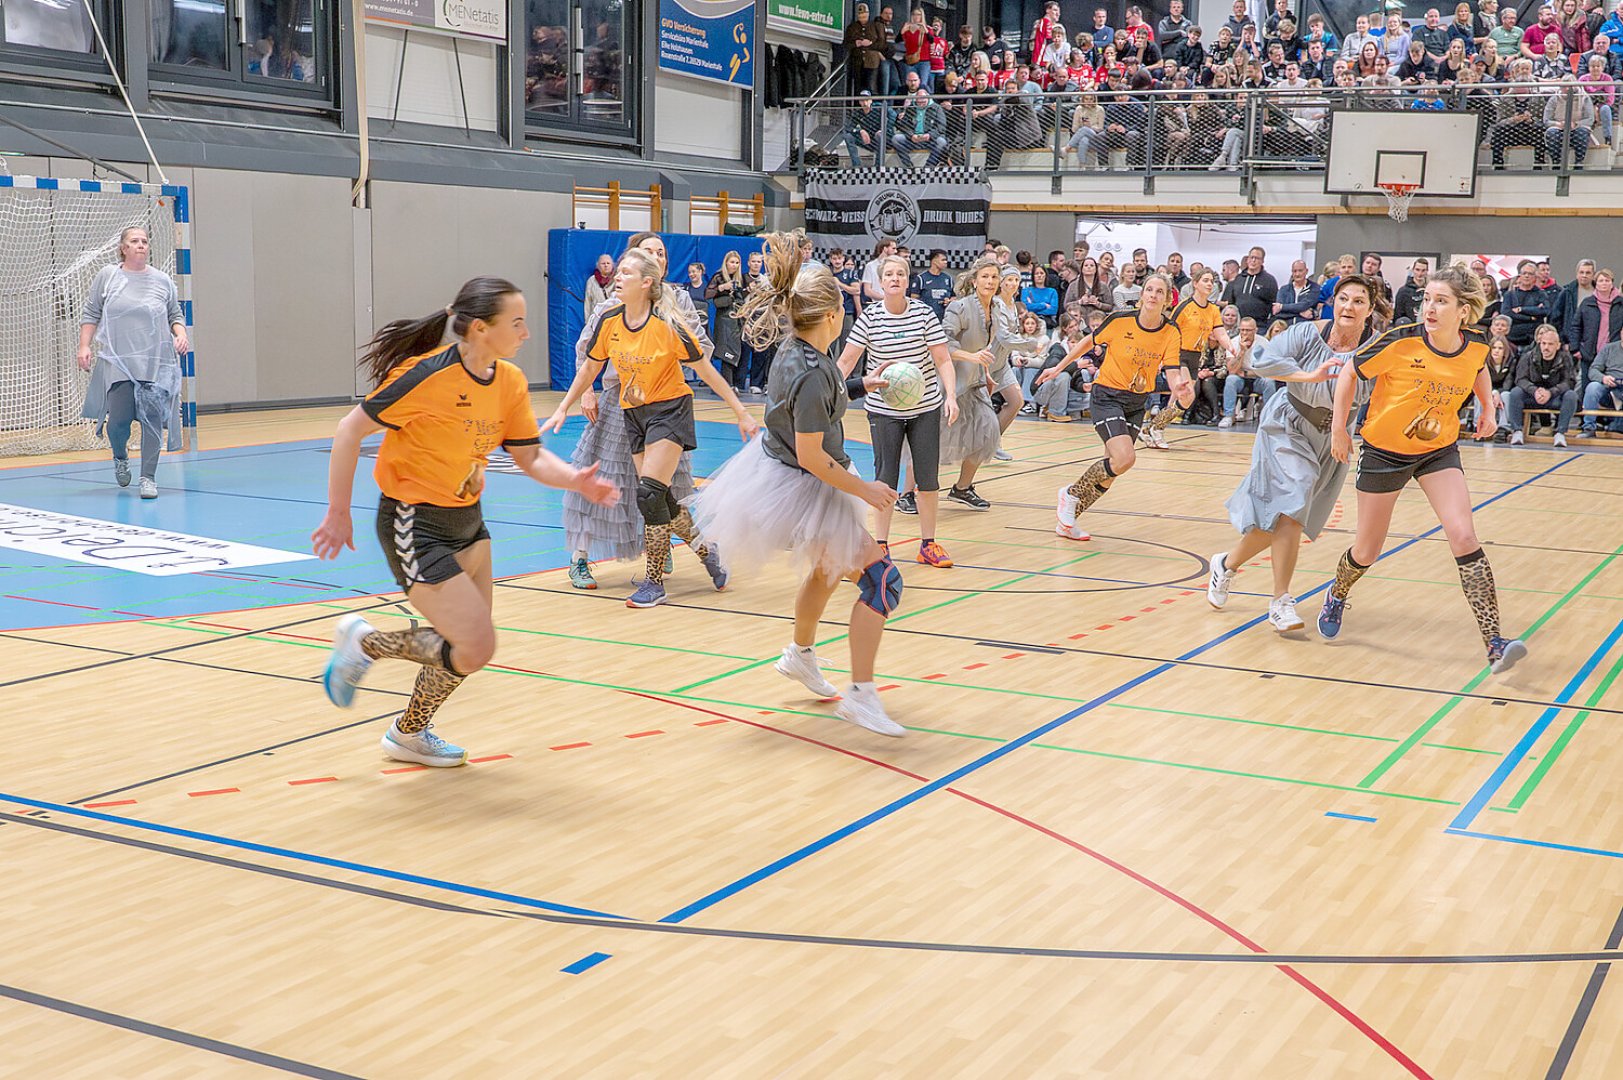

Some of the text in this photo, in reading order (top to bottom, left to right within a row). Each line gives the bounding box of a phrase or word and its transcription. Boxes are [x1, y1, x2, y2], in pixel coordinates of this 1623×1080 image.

[673, 21, 706, 39] Versicherung
[923, 210, 953, 223] DRUNK
[955, 210, 985, 224] DUDES
